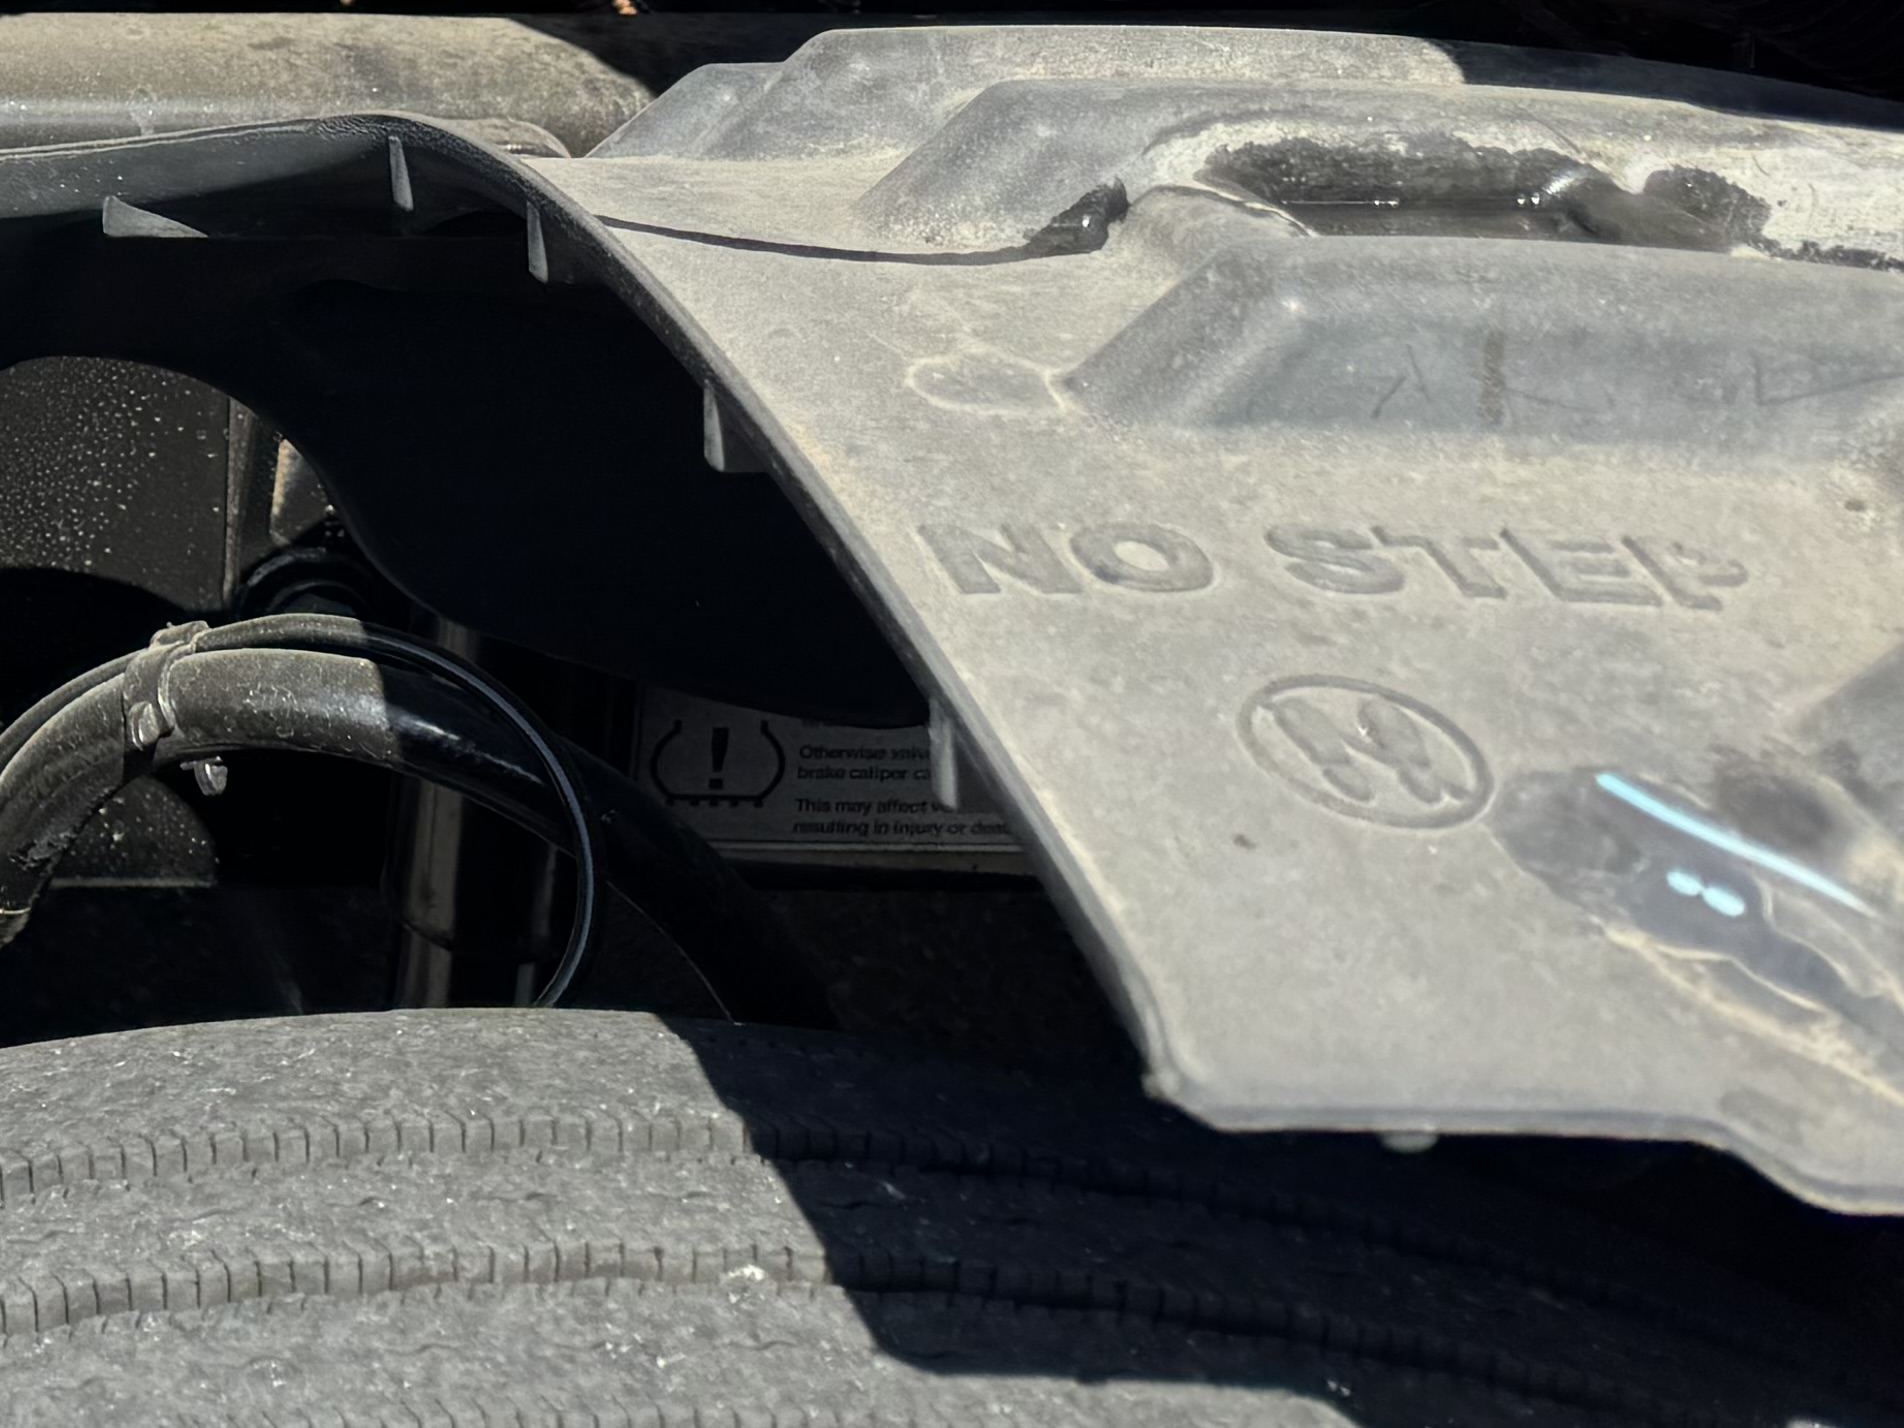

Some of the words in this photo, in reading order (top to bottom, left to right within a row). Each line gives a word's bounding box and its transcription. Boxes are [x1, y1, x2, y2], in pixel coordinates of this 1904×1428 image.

[914, 523, 1218, 597] NO
[1263, 523, 1752, 612] STEP
[799, 744, 887, 761] Otherwise
[797, 766, 845, 780] brake
[849, 767, 907, 783] caliper
[795, 799, 831, 813] This
[834, 800, 872, 815] may
[793, 820, 870, 837] resulting
[874, 820, 889, 835] in
[947, 823, 965, 835] or
